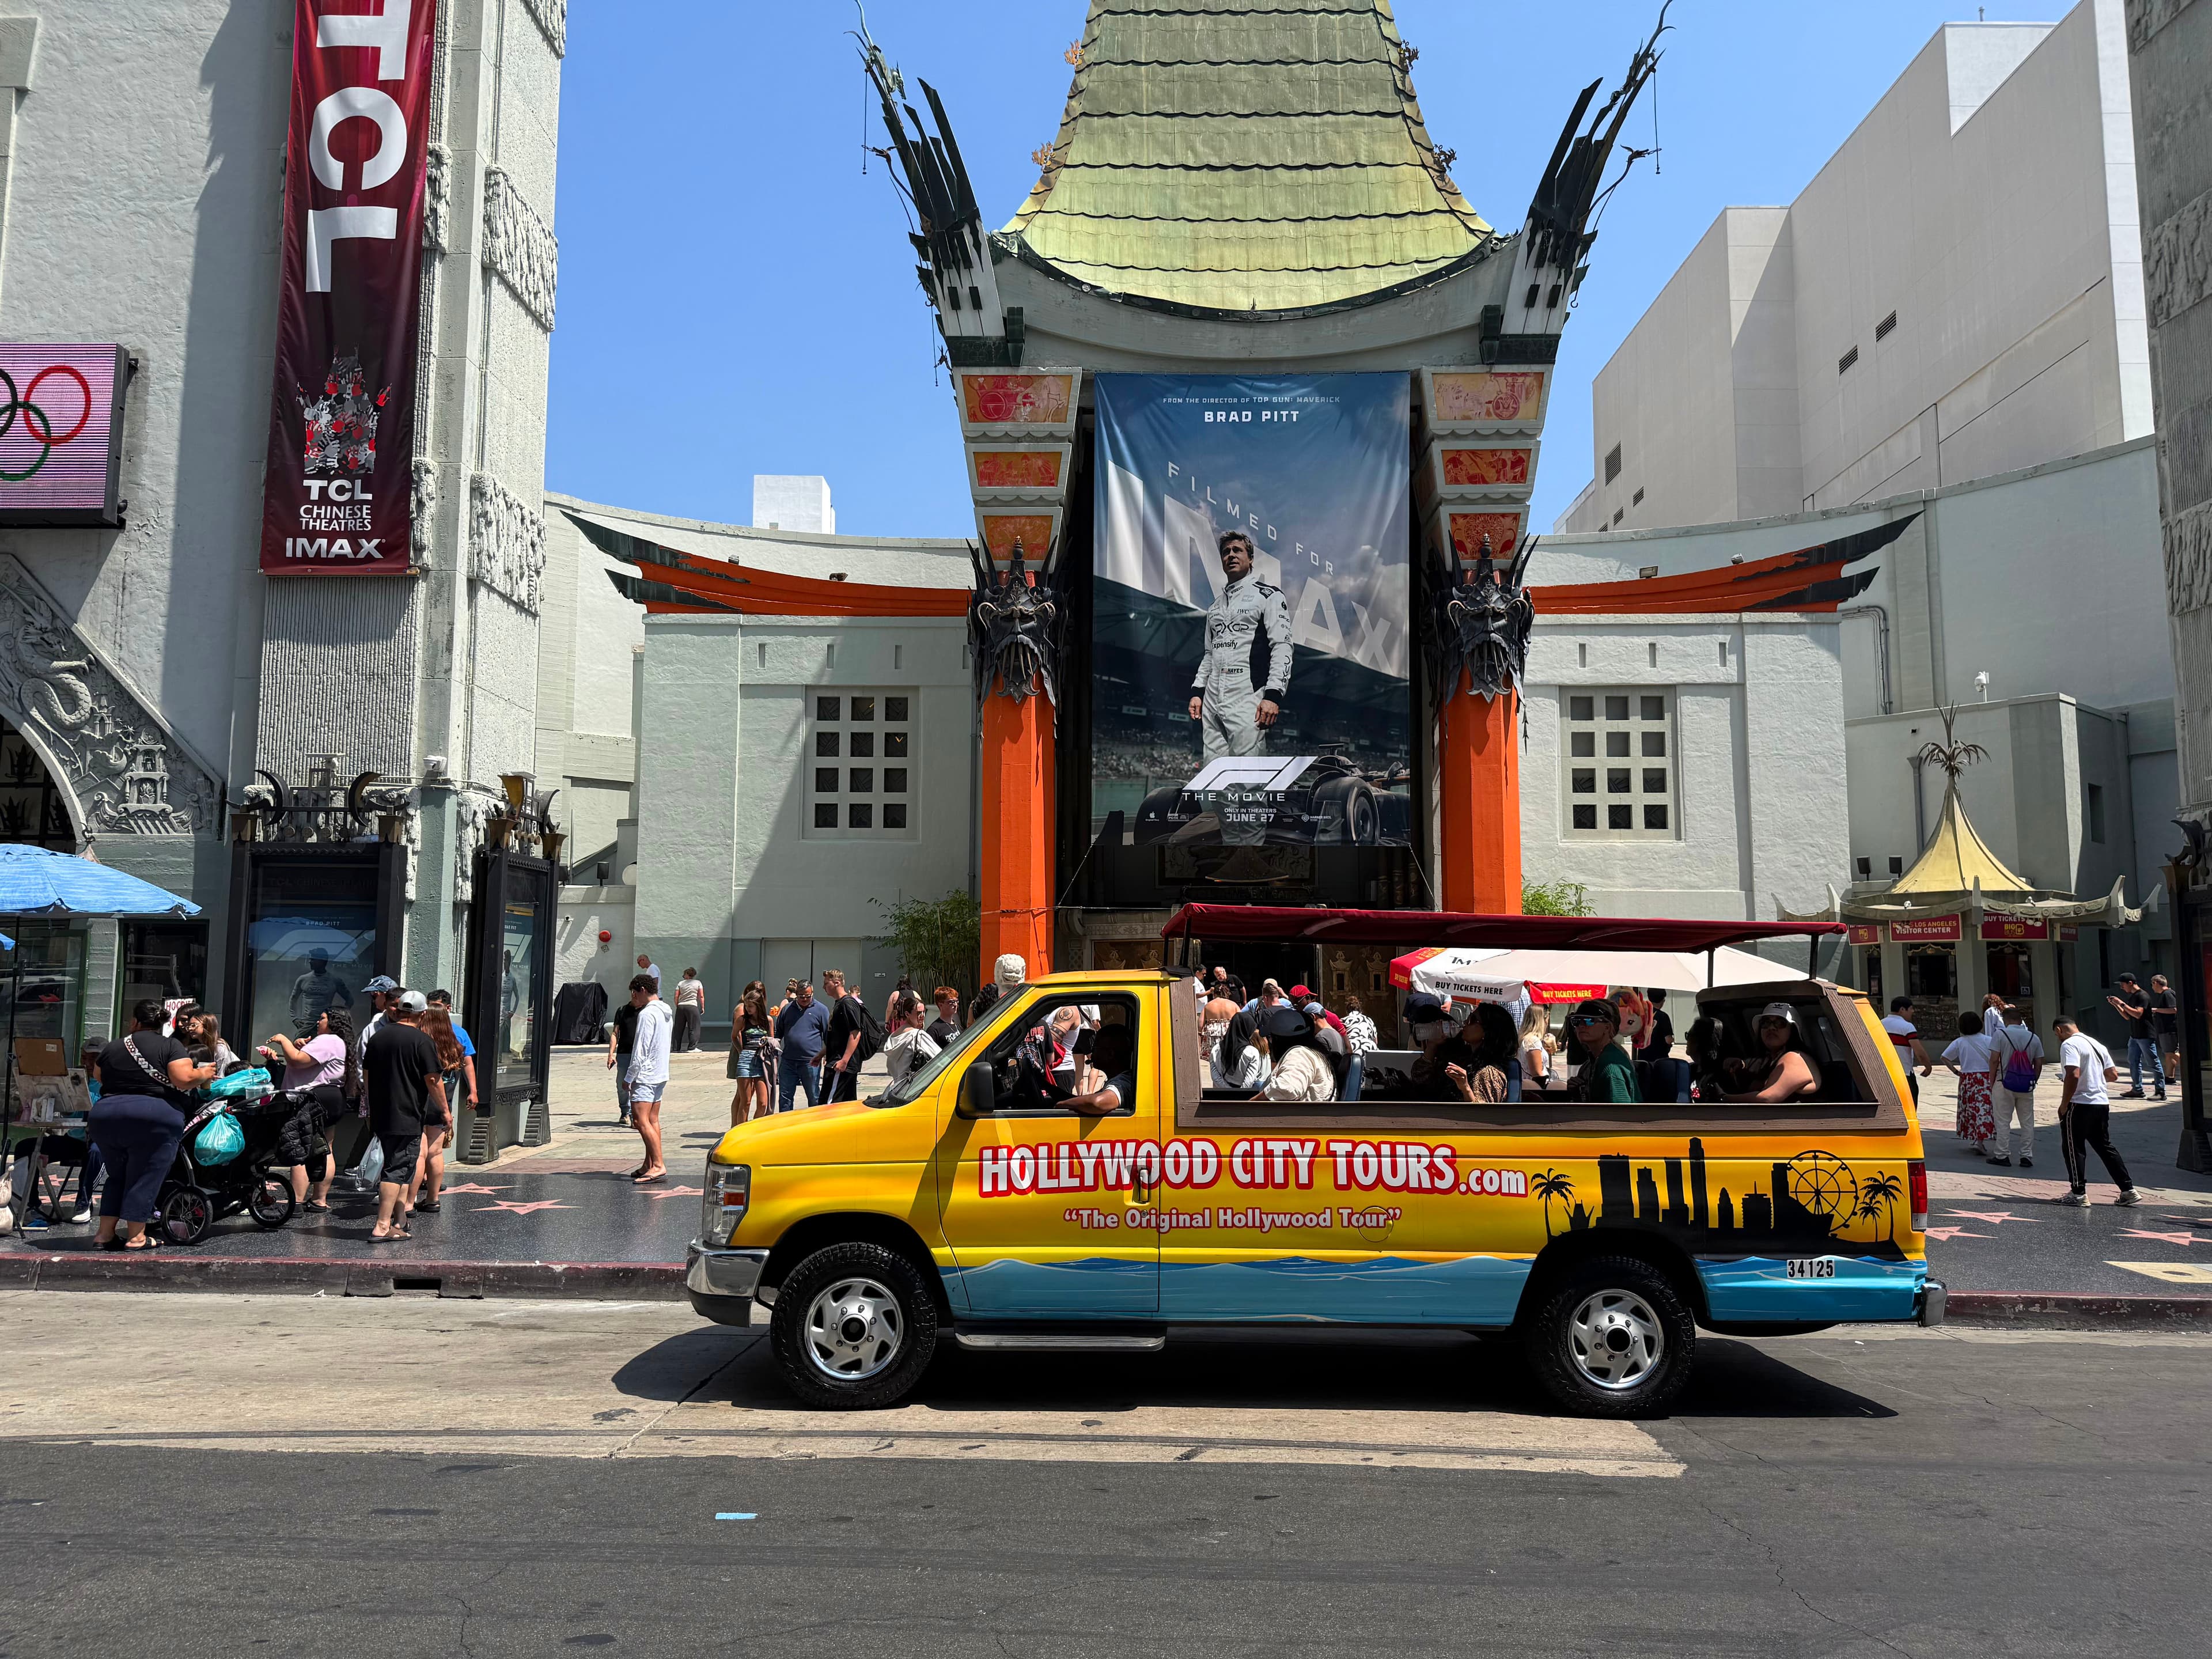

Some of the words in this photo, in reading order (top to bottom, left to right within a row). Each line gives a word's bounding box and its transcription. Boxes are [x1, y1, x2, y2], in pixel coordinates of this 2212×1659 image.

[305, 0, 411, 293] TCL
[1205, 411, 1252, 422] BRAD
[1262, 411, 1299, 422] PITT
[303, 479, 373, 502] TCL
[300, 505, 372, 518] CHINESE
[1168, 461, 1277, 540] FILMED
[1296, 542, 1334, 575] FOR
[300, 518, 372, 531] THEATRES
[286, 538, 384, 559] IMAX
[1228, 793, 1285, 801] MOVIE
[1226, 814, 1256, 822] JUNE
[1260, 814, 1274, 822] 27
[1450, 956, 1479, 965] TM
[1435, 982, 1450, 990] BUY
[1453, 983, 1481, 993] TICKETS
[1484, 986, 1503, 995] HERE
[976, 1140, 1218, 1193] HOLLYWOOD
[1232, 1140, 1316, 1184] CITY
[1126, 1210, 1210, 1233] Original
[1217, 1209, 1331, 1232] Hollywood
[1788, 1260, 1834, 1277] 34125
